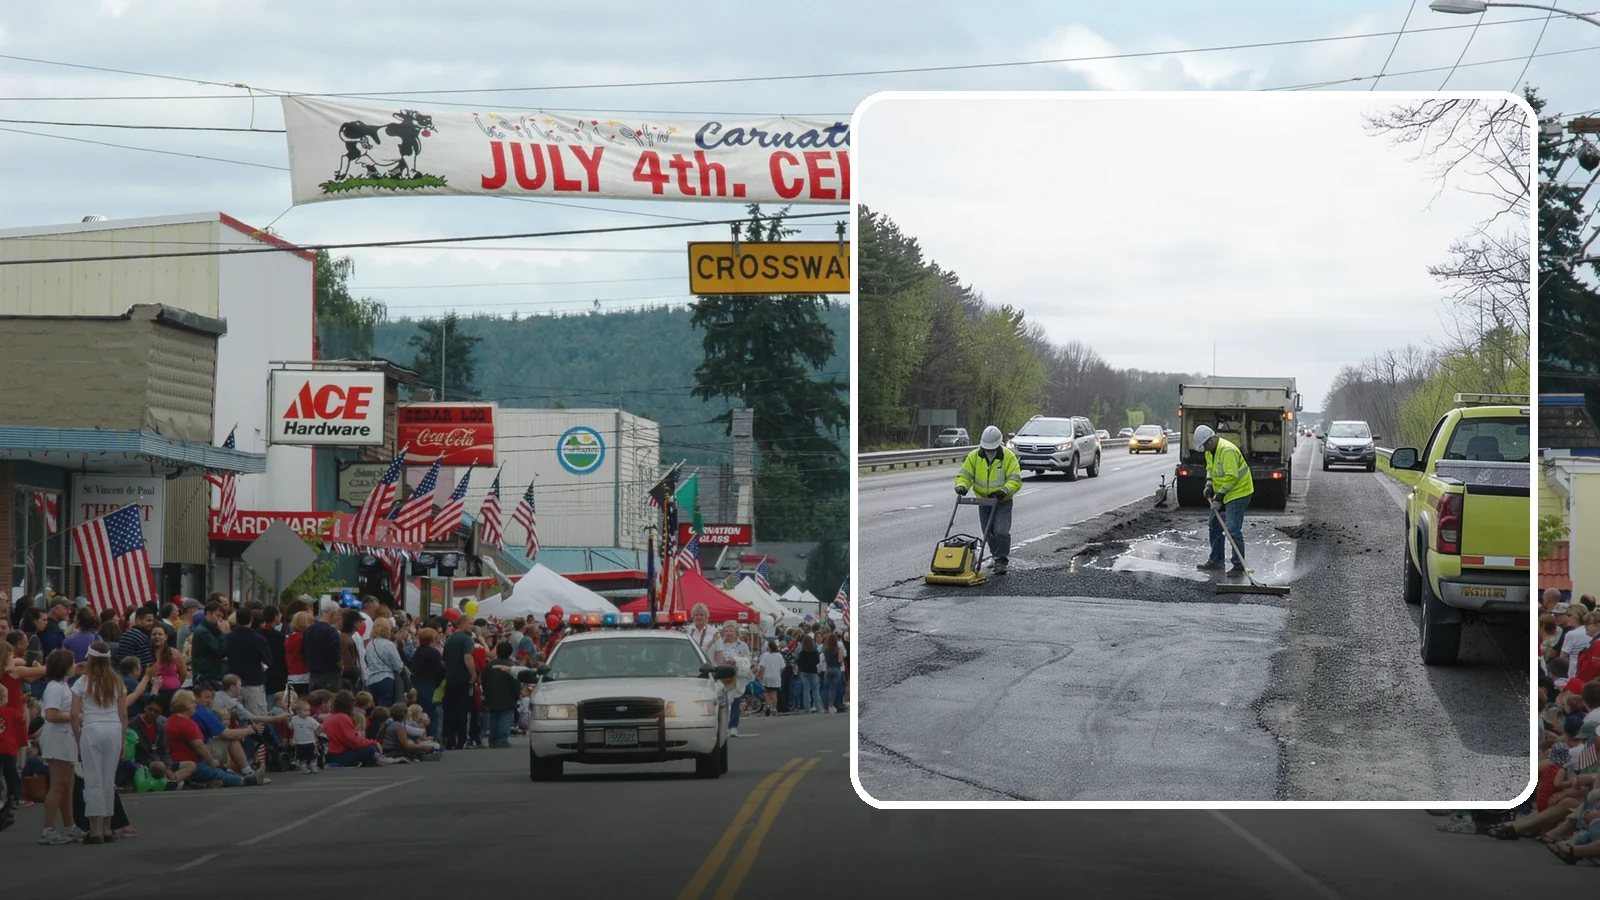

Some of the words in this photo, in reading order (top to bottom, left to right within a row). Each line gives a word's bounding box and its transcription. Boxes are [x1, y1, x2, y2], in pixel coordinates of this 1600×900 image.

[481, 141, 604, 192] JULY
[632, 150, 746, 198] 4th.
[697, 254, 850, 280] CROSSWA
[283, 380, 373, 420] ACE
[406, 409, 452, 422] CEDAR
[461, 409, 485, 421] LOG
[283, 421, 371, 436] Hardware
[353, 466, 387, 479] Simpl
[95, 485, 124, 495] Vincent
[126, 486, 135, 495] de
[137, 486, 155, 495] Paul
[212, 516, 331, 535] HARDARE
[688, 526, 741, 535] CRNATION
[699, 535, 730, 543] GLASS
